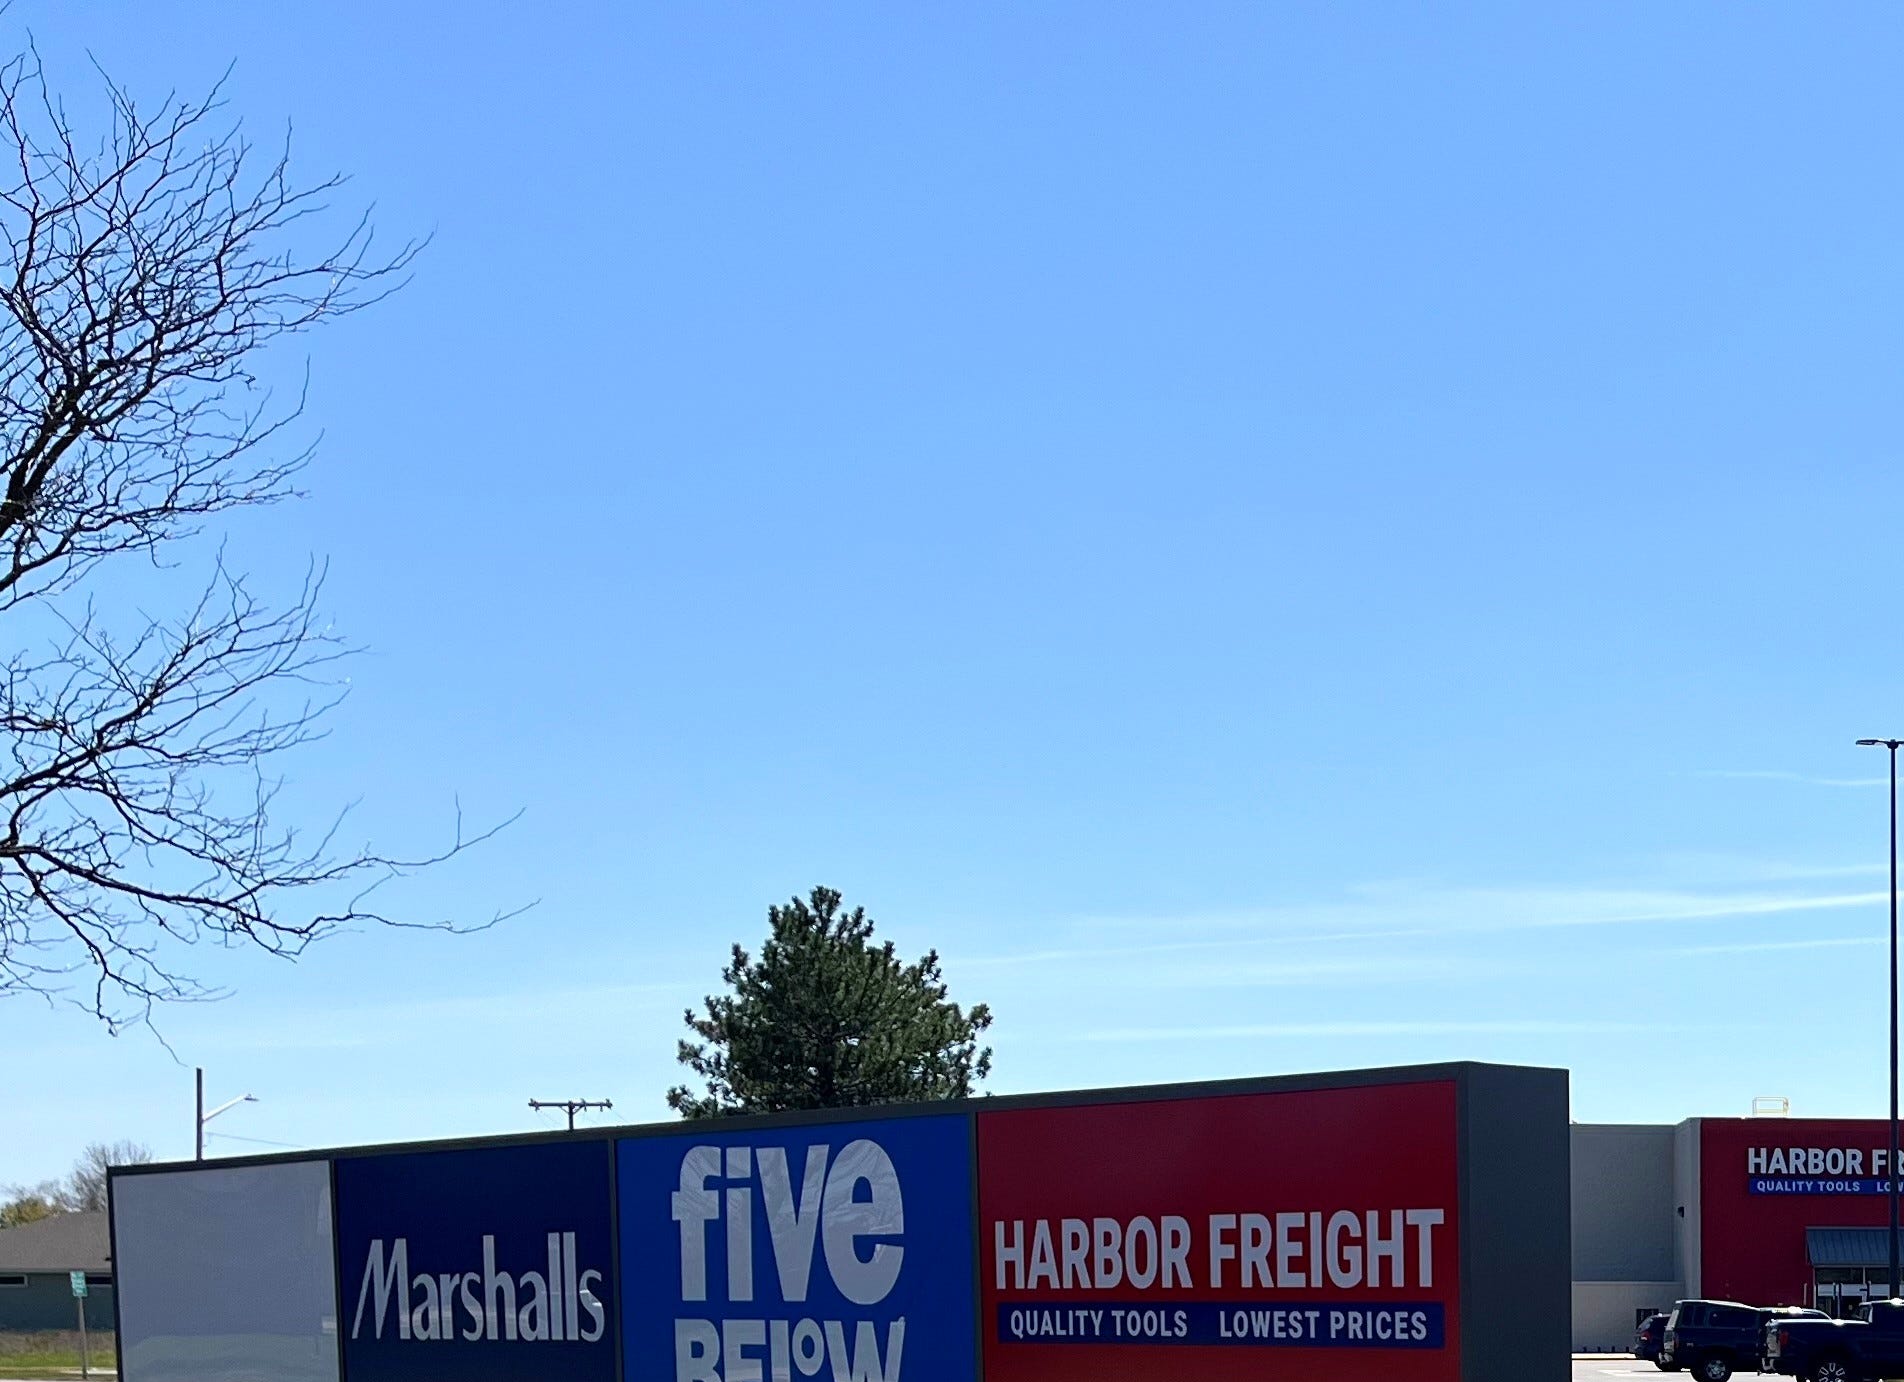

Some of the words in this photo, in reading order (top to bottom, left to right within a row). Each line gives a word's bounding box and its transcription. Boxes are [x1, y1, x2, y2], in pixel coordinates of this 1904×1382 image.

[1748, 1147, 1864, 1176] HARBOR
[1757, 1180, 1813, 1192] QUALITY
[1818, 1180, 1860, 1192] TOOLS
[994, 1216, 1194, 1290] HARBOR
[1208, 1208, 1445, 1289] FREIGHT
[352, 1231, 605, 1343] Marshalls
[1010, 1309, 1104, 1340] QUALITY
[1110, 1309, 1188, 1338] TOOLS
[1219, 1309, 1320, 1339] LOWEST
[1329, 1310, 1428, 1341] PRICES
